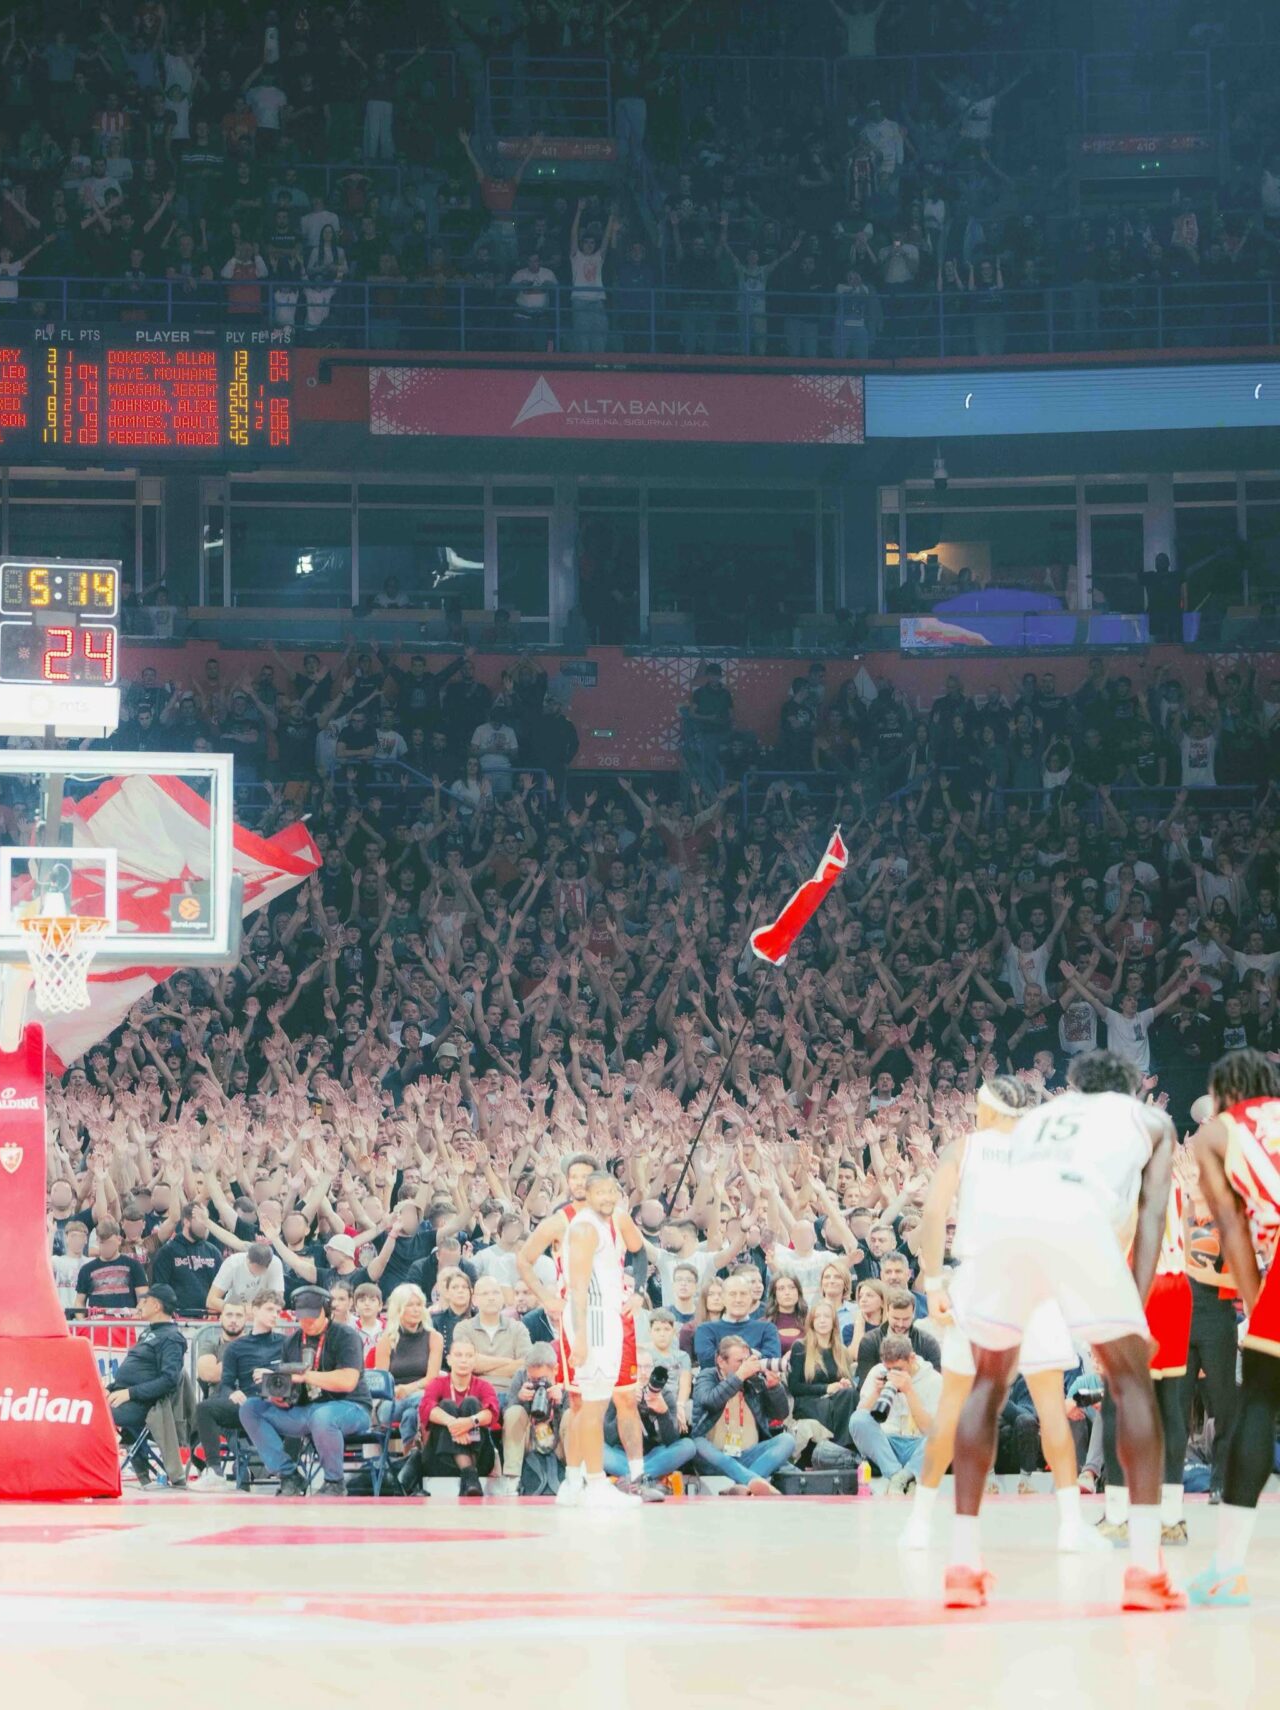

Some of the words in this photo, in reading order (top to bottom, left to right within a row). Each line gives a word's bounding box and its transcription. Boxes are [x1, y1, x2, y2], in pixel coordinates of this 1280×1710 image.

[35, 329, 54, 340] PLY
[61, 330, 73, 340] FL
[80, 330, 100, 340] PTS
[136, 331, 189, 342] PLAYER
[226, 332, 245, 342] PLY
[252, 332, 264, 343] FL
[271, 332, 290, 343] PTS
[48, 349, 56, 363] 3
[235, 351, 247, 365] 13
[270, 352, 288, 365] 05
[2, 366, 25, 378] LEO
[80, 365, 97, 379] 04
[108, 368, 148, 380] FAYE,
[235, 367, 247, 381] 15
[270, 368, 288, 381] 04
[84, 381, 97, 394] 14
[109, 384, 165, 396] MORGAN,
[172, 384, 218, 396] JEREM
[229, 383, 248, 397] 20
[48, 397, 56, 411] 8
[79, 398, 97, 411] 07
[109, 400, 172, 413] JOHNSON,
[179, 400, 216, 413] ALIZE
[230, 400, 248, 413] 24
[270, 399, 288, 413] 02
[567, 400, 709, 415] ALTABANKA
[48, 413, 56, 427] 9
[84, 414, 97, 427] 19
[108, 416, 167, 428] HOMMES,
[230, 416, 248, 429] 34
[270, 415, 288, 429] 08
[44, 429, 56, 442] 11
[80, 429, 97, 443] 03
[108, 431, 171, 444] PEREIRA,
[230, 431, 248, 445] 45
[270, 431, 289, 445] 04
[45, 629, 112, 679] 24
[1034, 1112, 1084, 1142] 15
